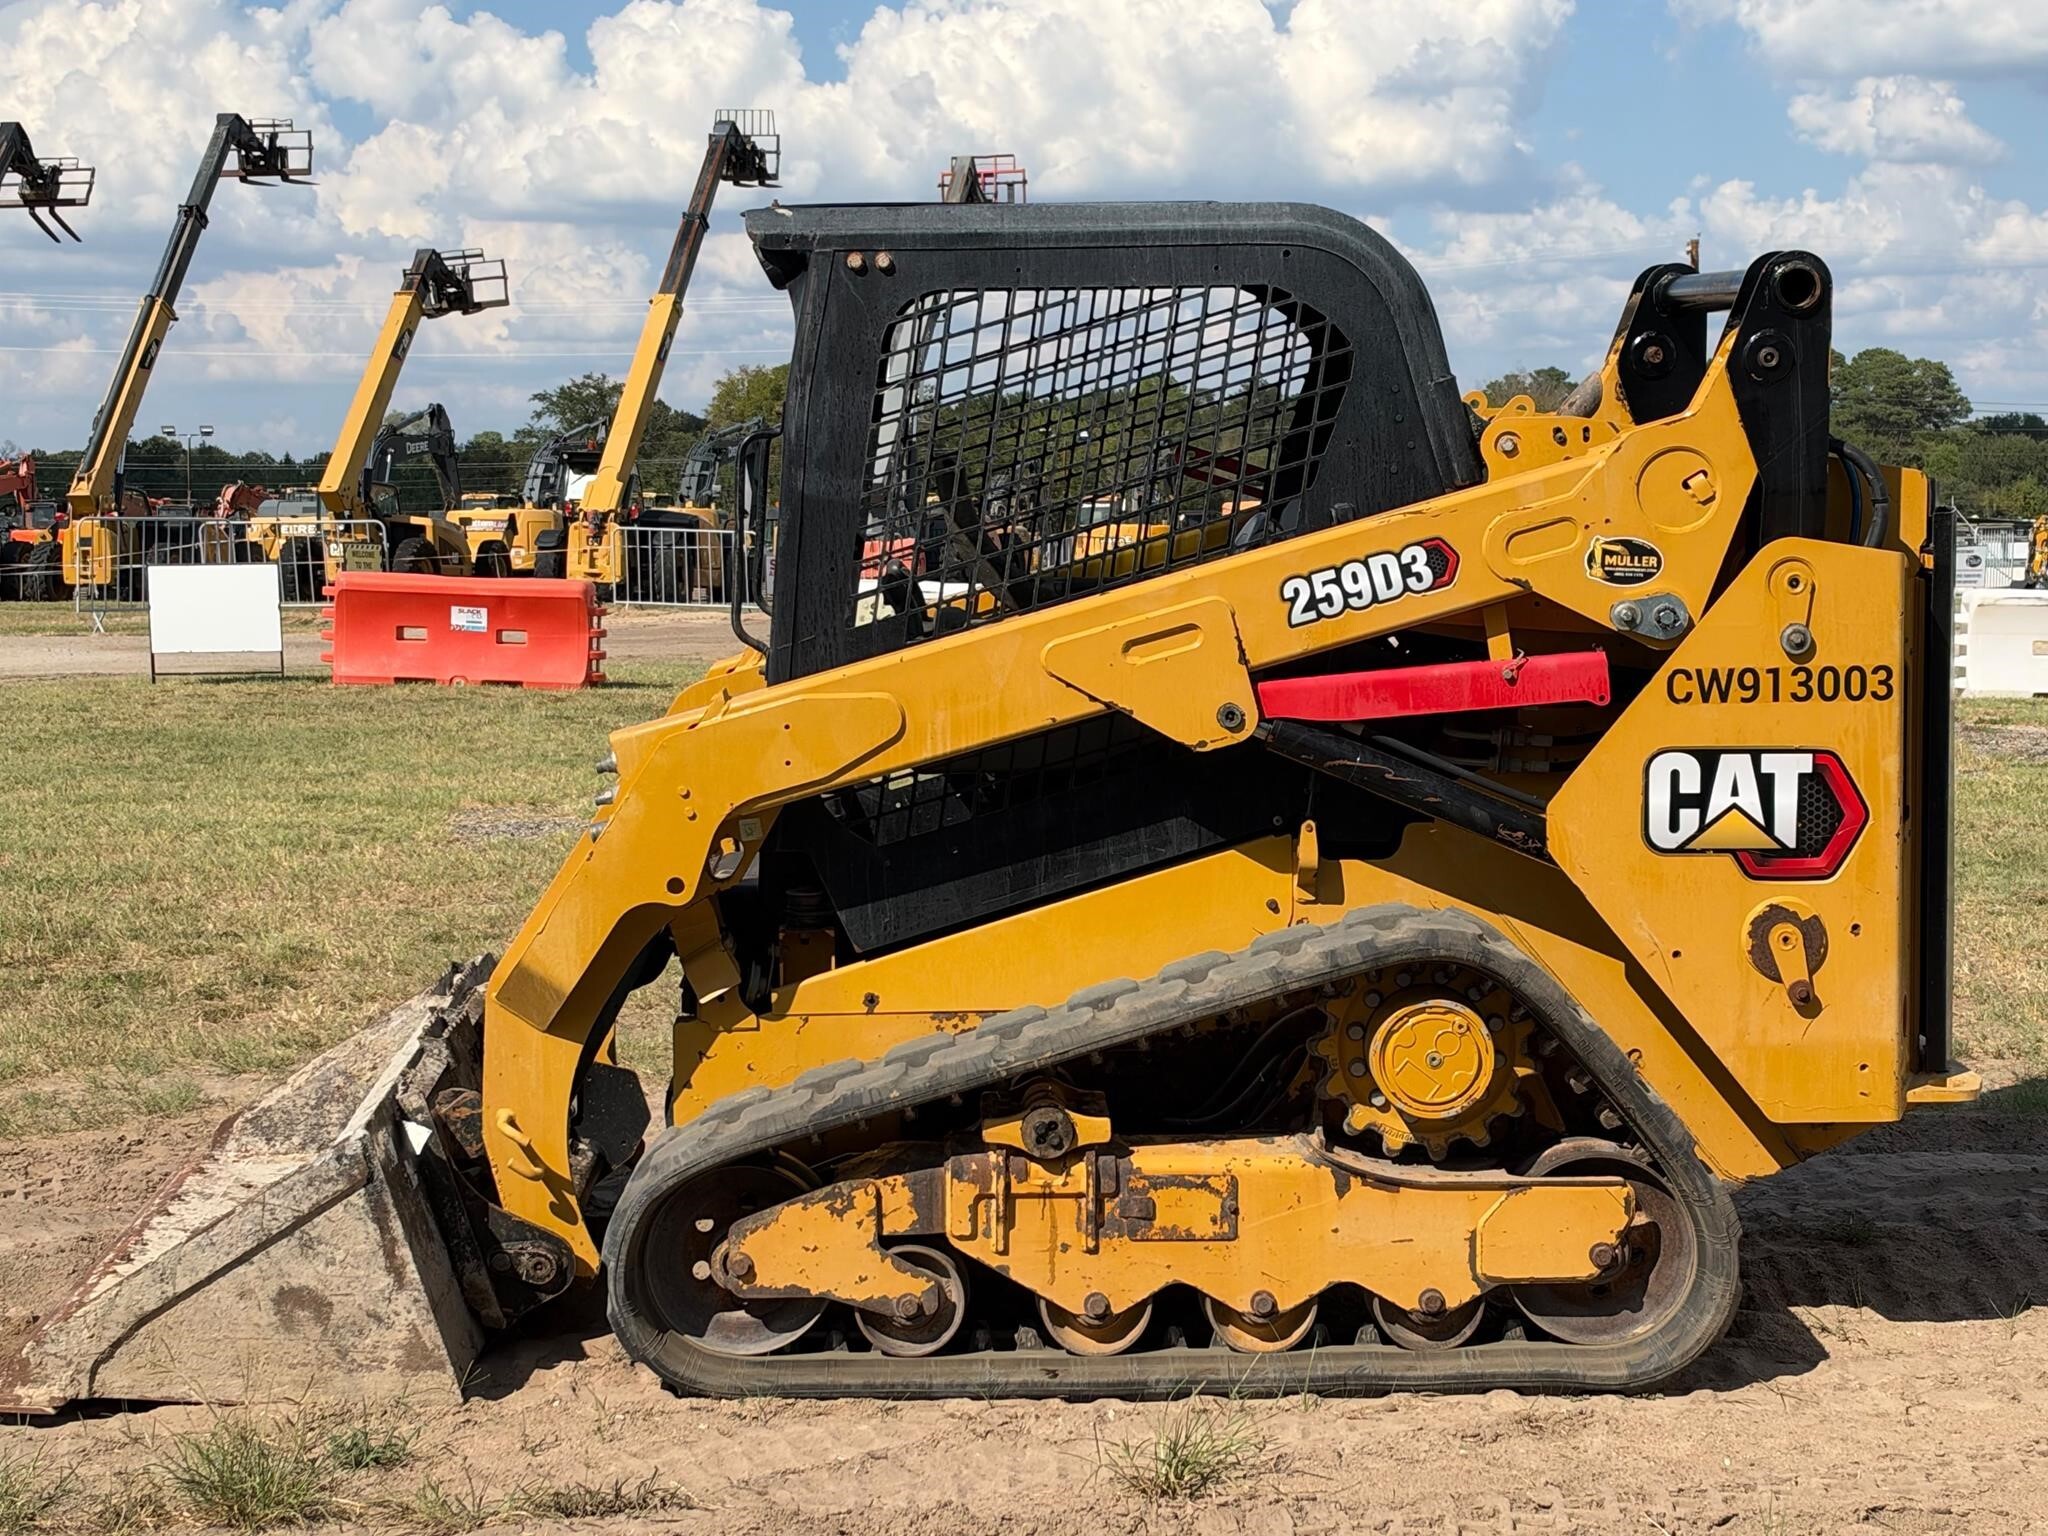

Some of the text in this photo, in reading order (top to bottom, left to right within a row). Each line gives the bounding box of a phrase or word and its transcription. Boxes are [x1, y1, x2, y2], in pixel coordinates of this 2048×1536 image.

[406, 441, 429, 454] DEERE
[1604, 554, 1658, 568] MULLER
[1283, 545, 1434, 625] 259D3
[1666, 665, 1895, 704] CW913003
[1648, 752, 1814, 849] CAT
